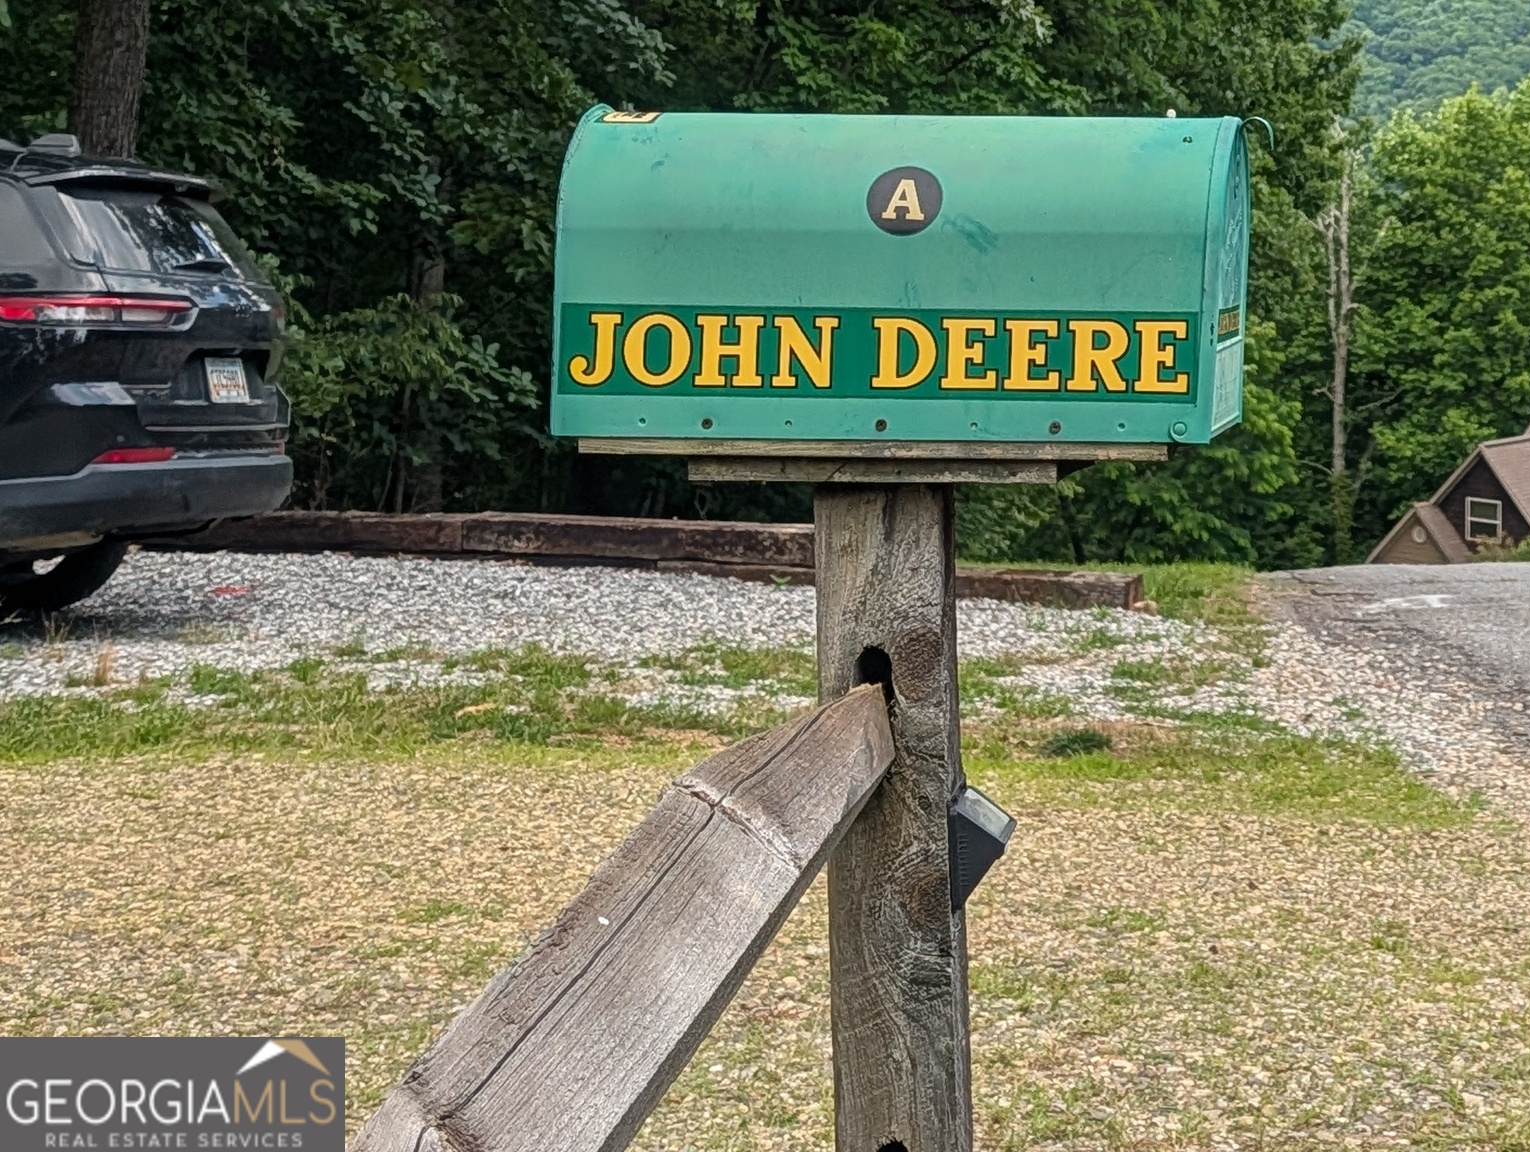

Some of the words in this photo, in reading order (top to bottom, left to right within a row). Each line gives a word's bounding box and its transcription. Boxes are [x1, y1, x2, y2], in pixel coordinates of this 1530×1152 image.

[881, 178, 925, 221] A
[567, 311, 841, 390] JOHN
[870, 316, 1192, 394] DEERE
